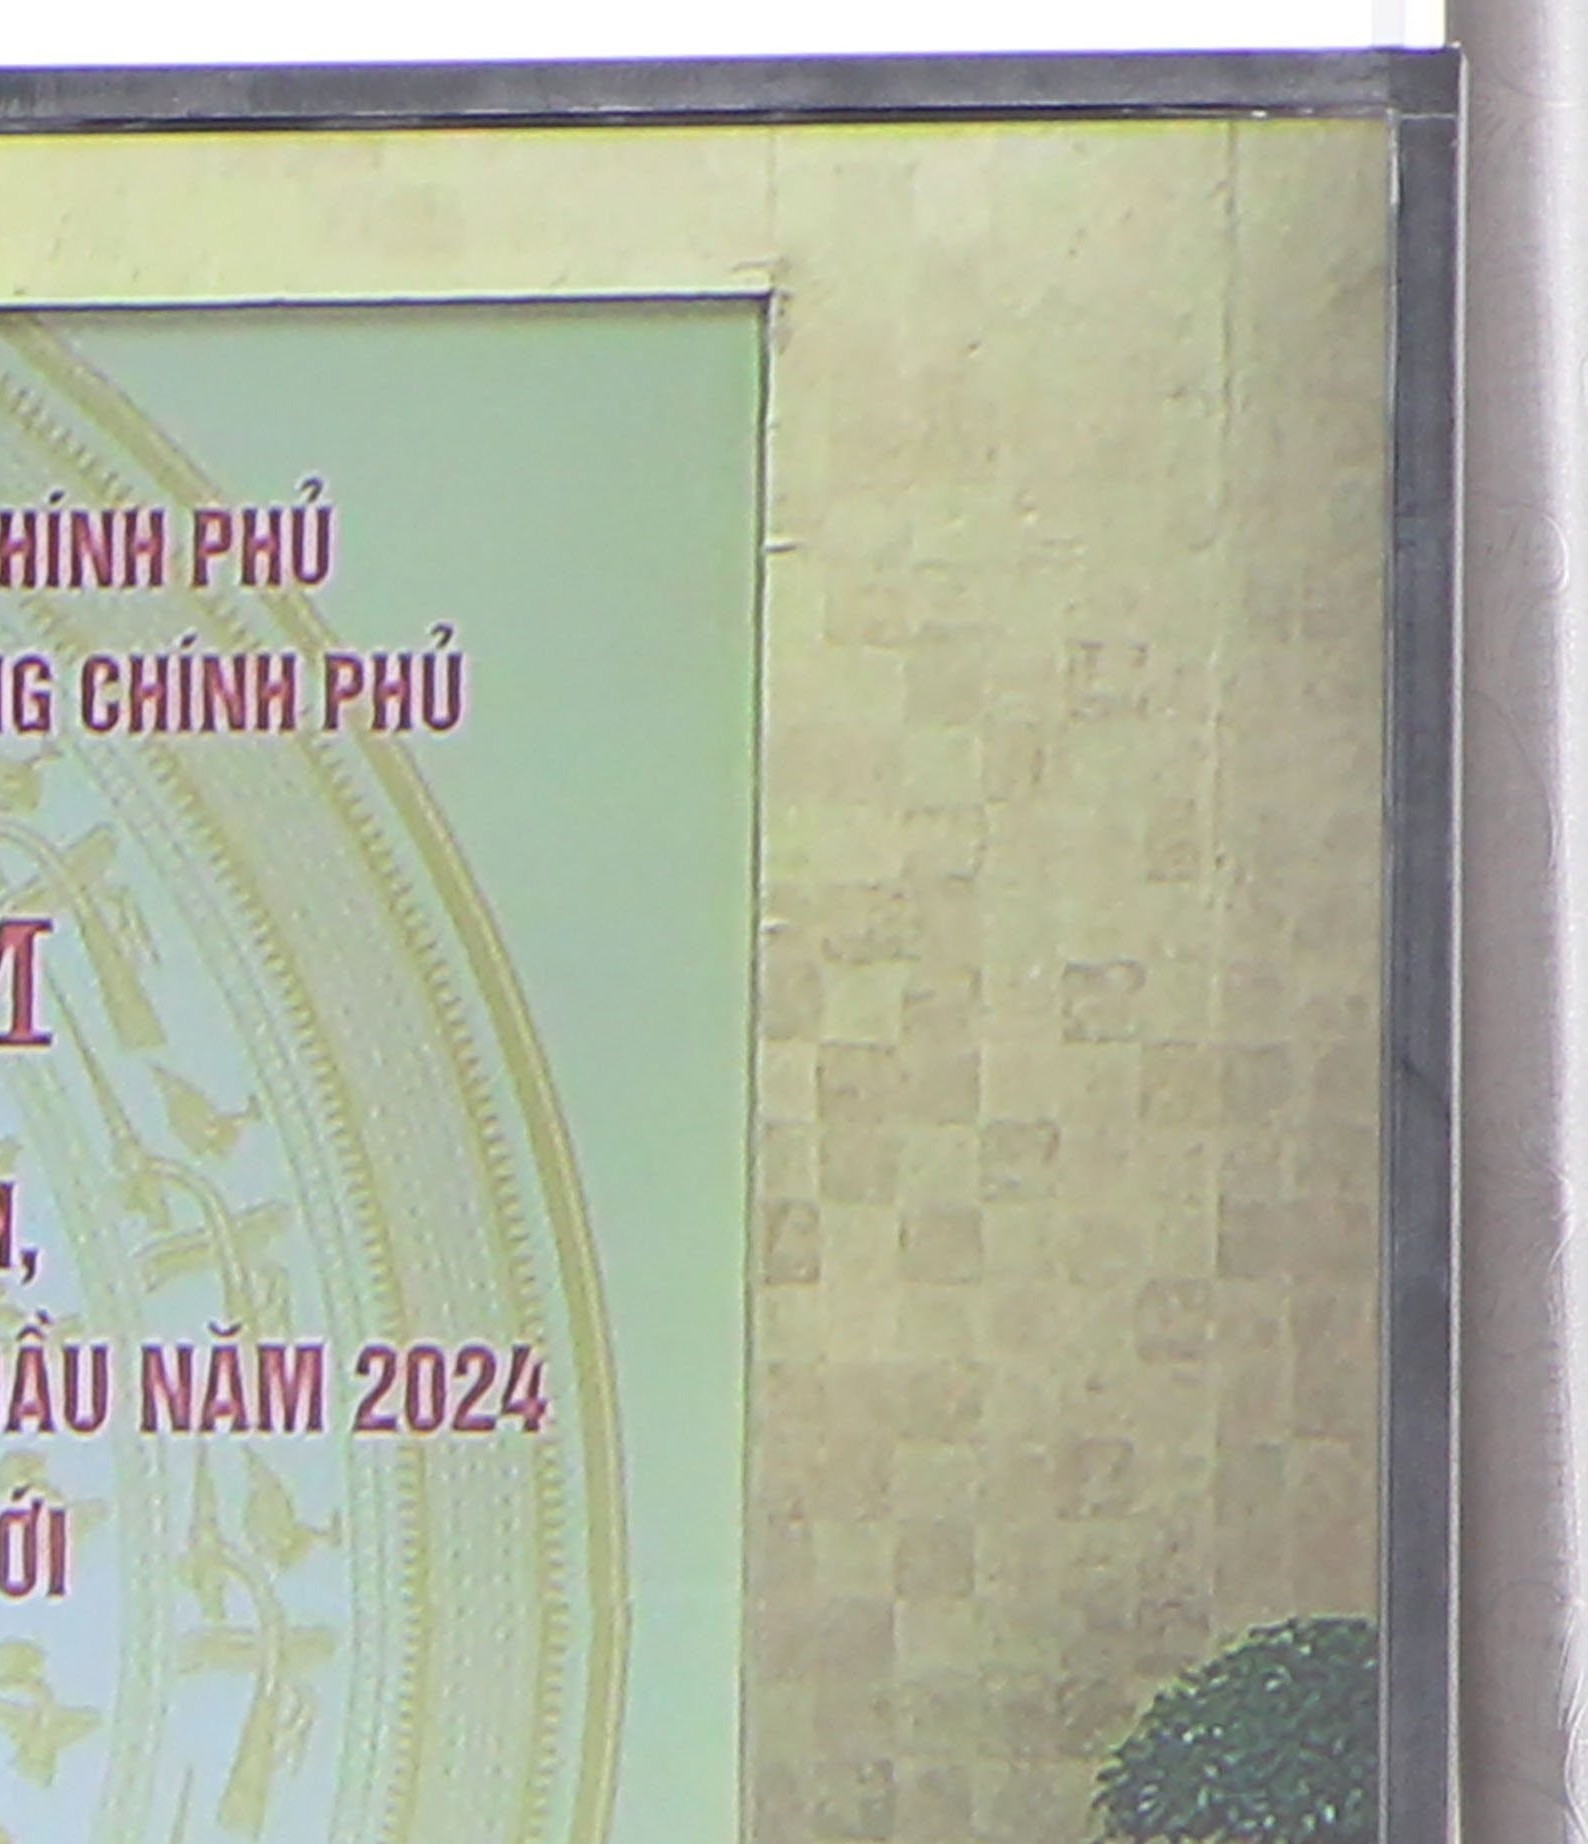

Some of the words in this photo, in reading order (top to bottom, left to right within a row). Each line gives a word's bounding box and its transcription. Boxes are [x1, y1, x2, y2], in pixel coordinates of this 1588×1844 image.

[192, 481, 332, 585] PHỦ
[82, 635, 297, 731] CHÍNH
[324, 625, 463, 731] PHỦ
[140, 1324, 324, 1432] NĂM
[356, 1346, 548, 1432] 2024
